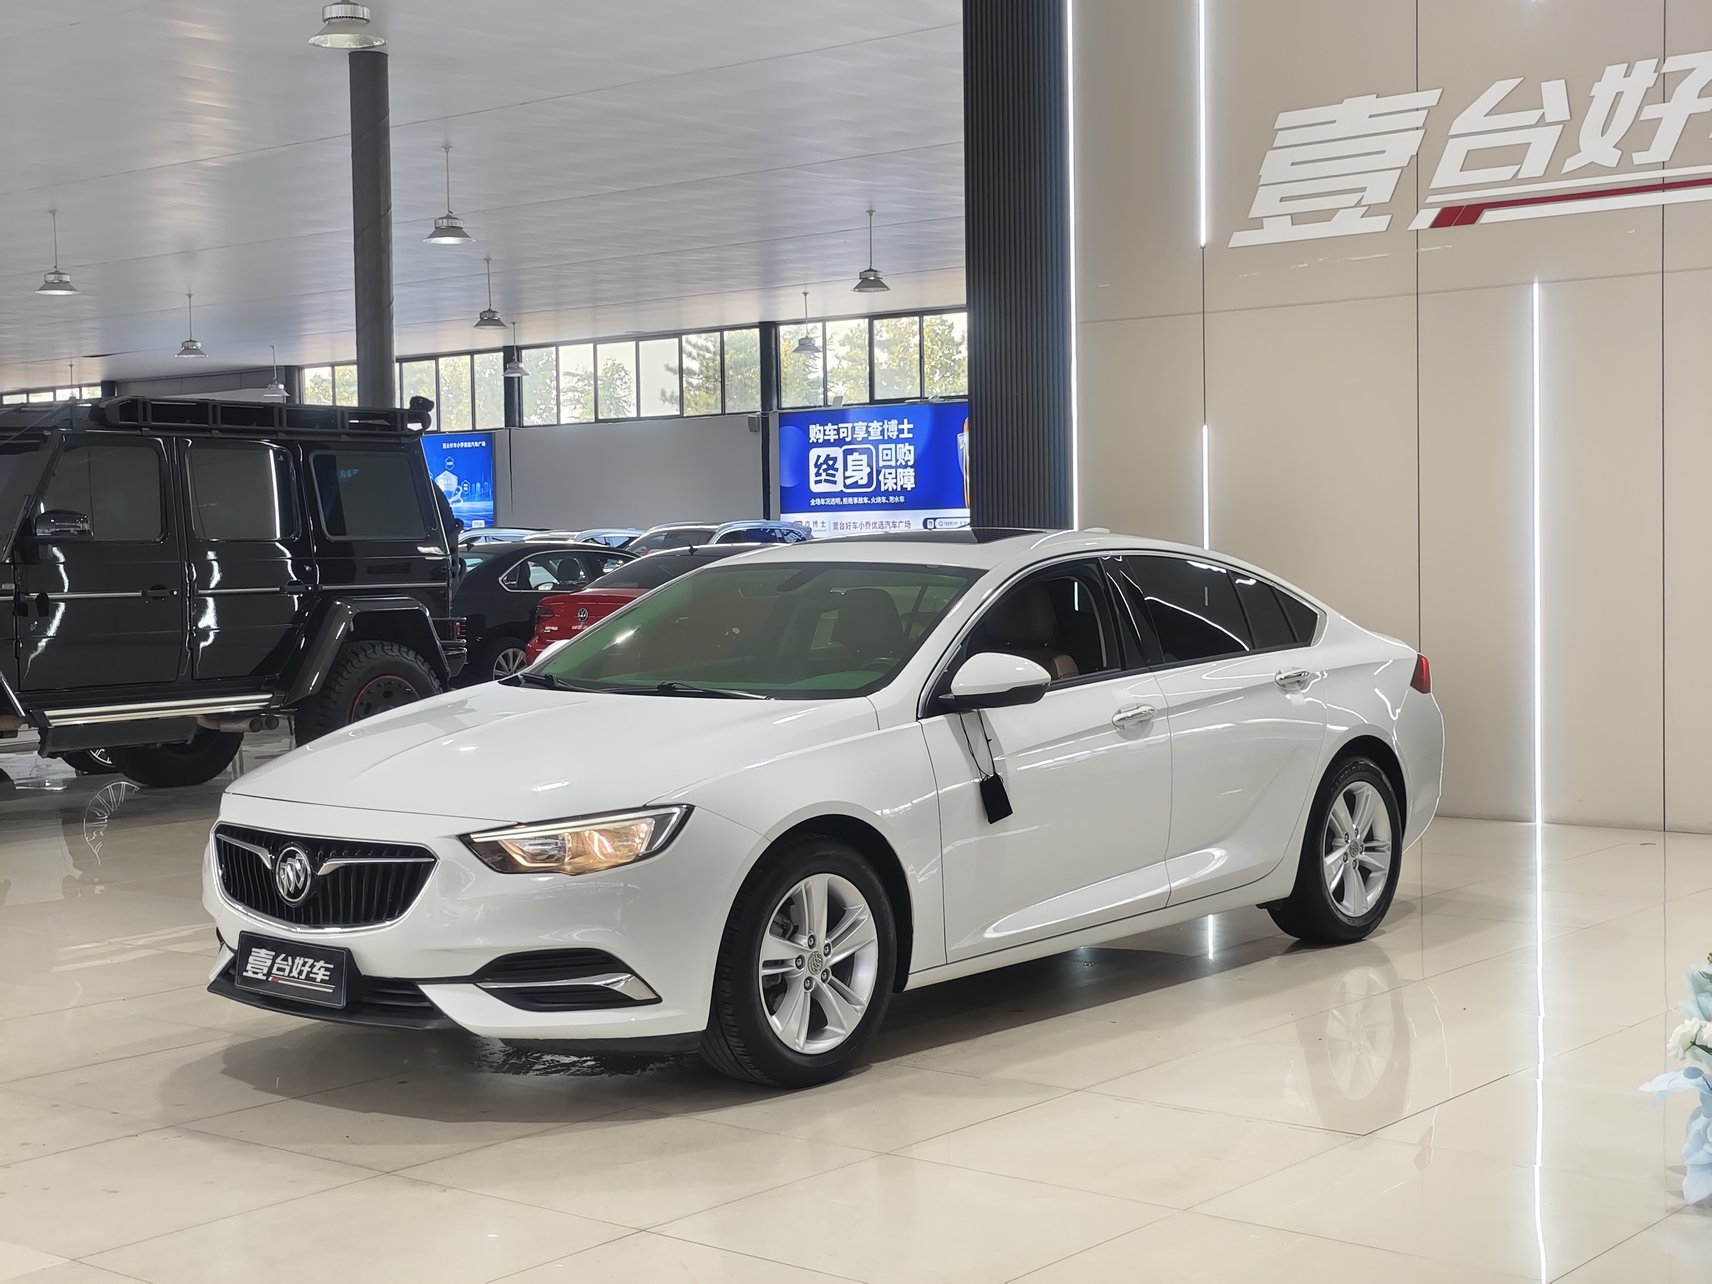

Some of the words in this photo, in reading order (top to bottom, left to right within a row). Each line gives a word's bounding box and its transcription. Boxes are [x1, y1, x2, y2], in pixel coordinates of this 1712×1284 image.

[809, 419, 914, 443] 购车可享查博士
[878, 442, 915, 467] 回购
[814, 451, 871, 486] 终身
[878, 468, 916, 492] 保障
[242, 947, 335, 983] 壹台好车
